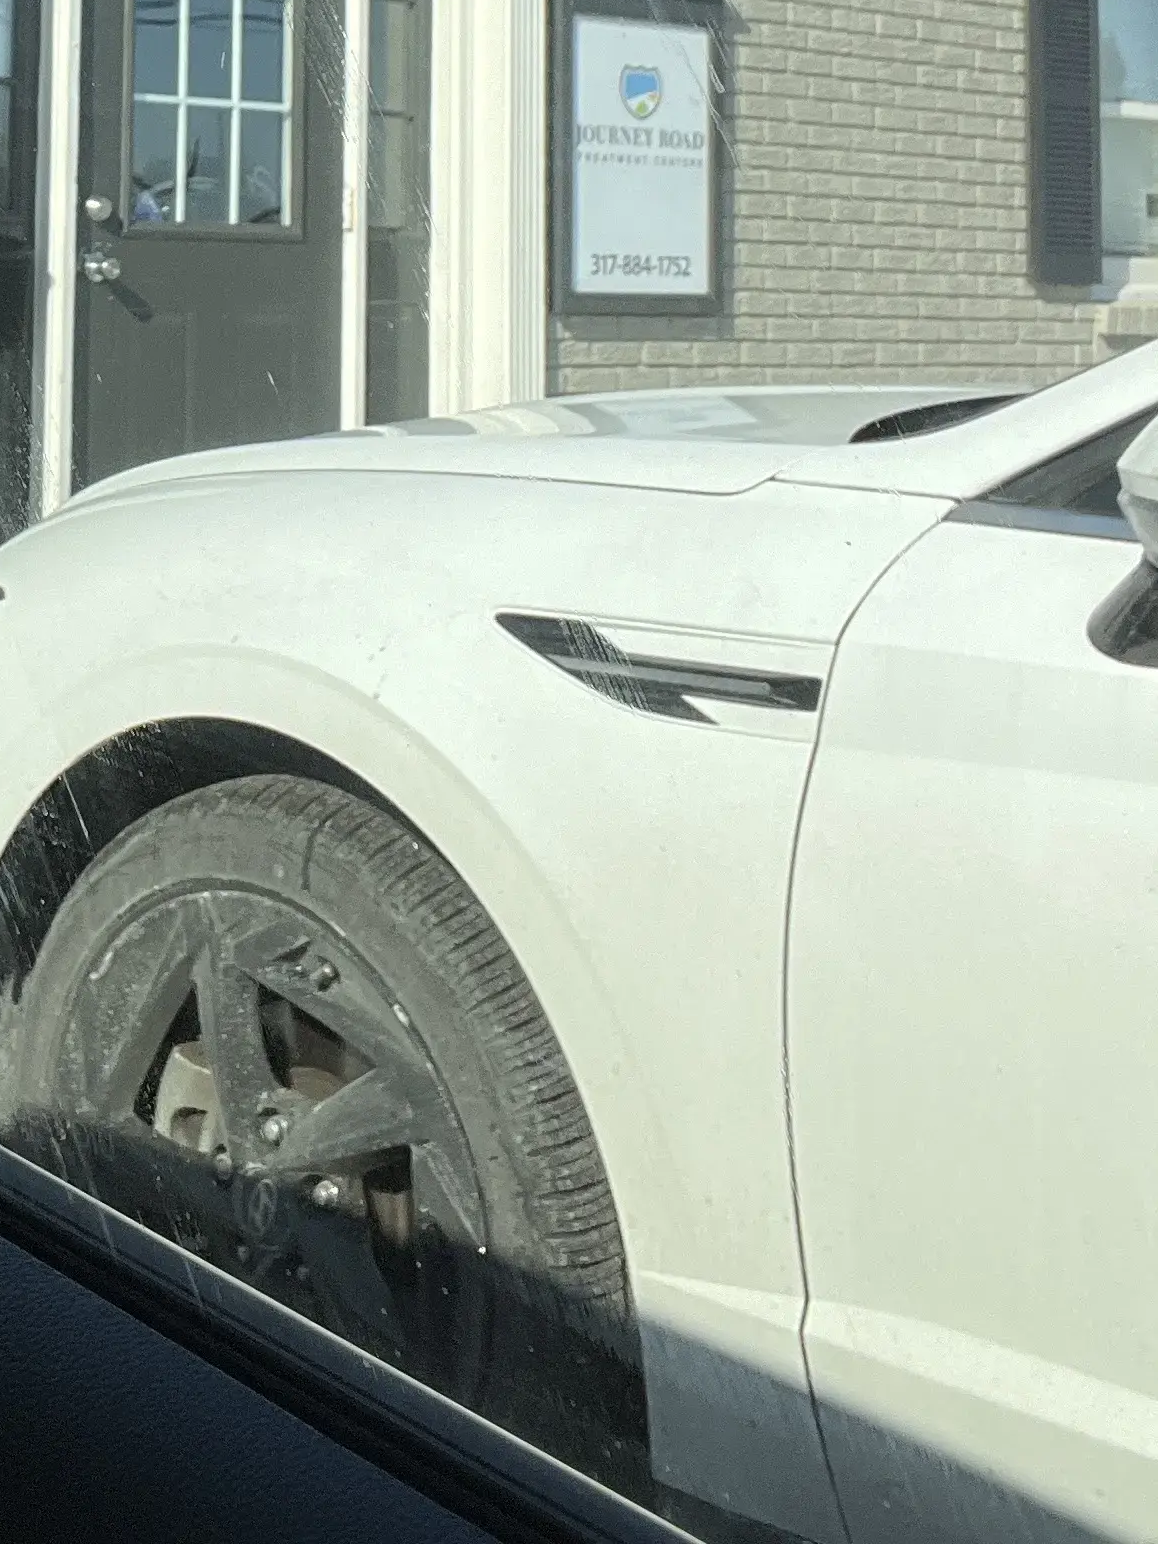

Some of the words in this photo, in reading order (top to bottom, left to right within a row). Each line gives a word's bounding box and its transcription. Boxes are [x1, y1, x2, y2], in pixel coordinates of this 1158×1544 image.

[576, 124, 654, 147] JOURNEY
[658, 129, 705, 149] ROAD
[590, 253, 692, 276] 317-884-1752
